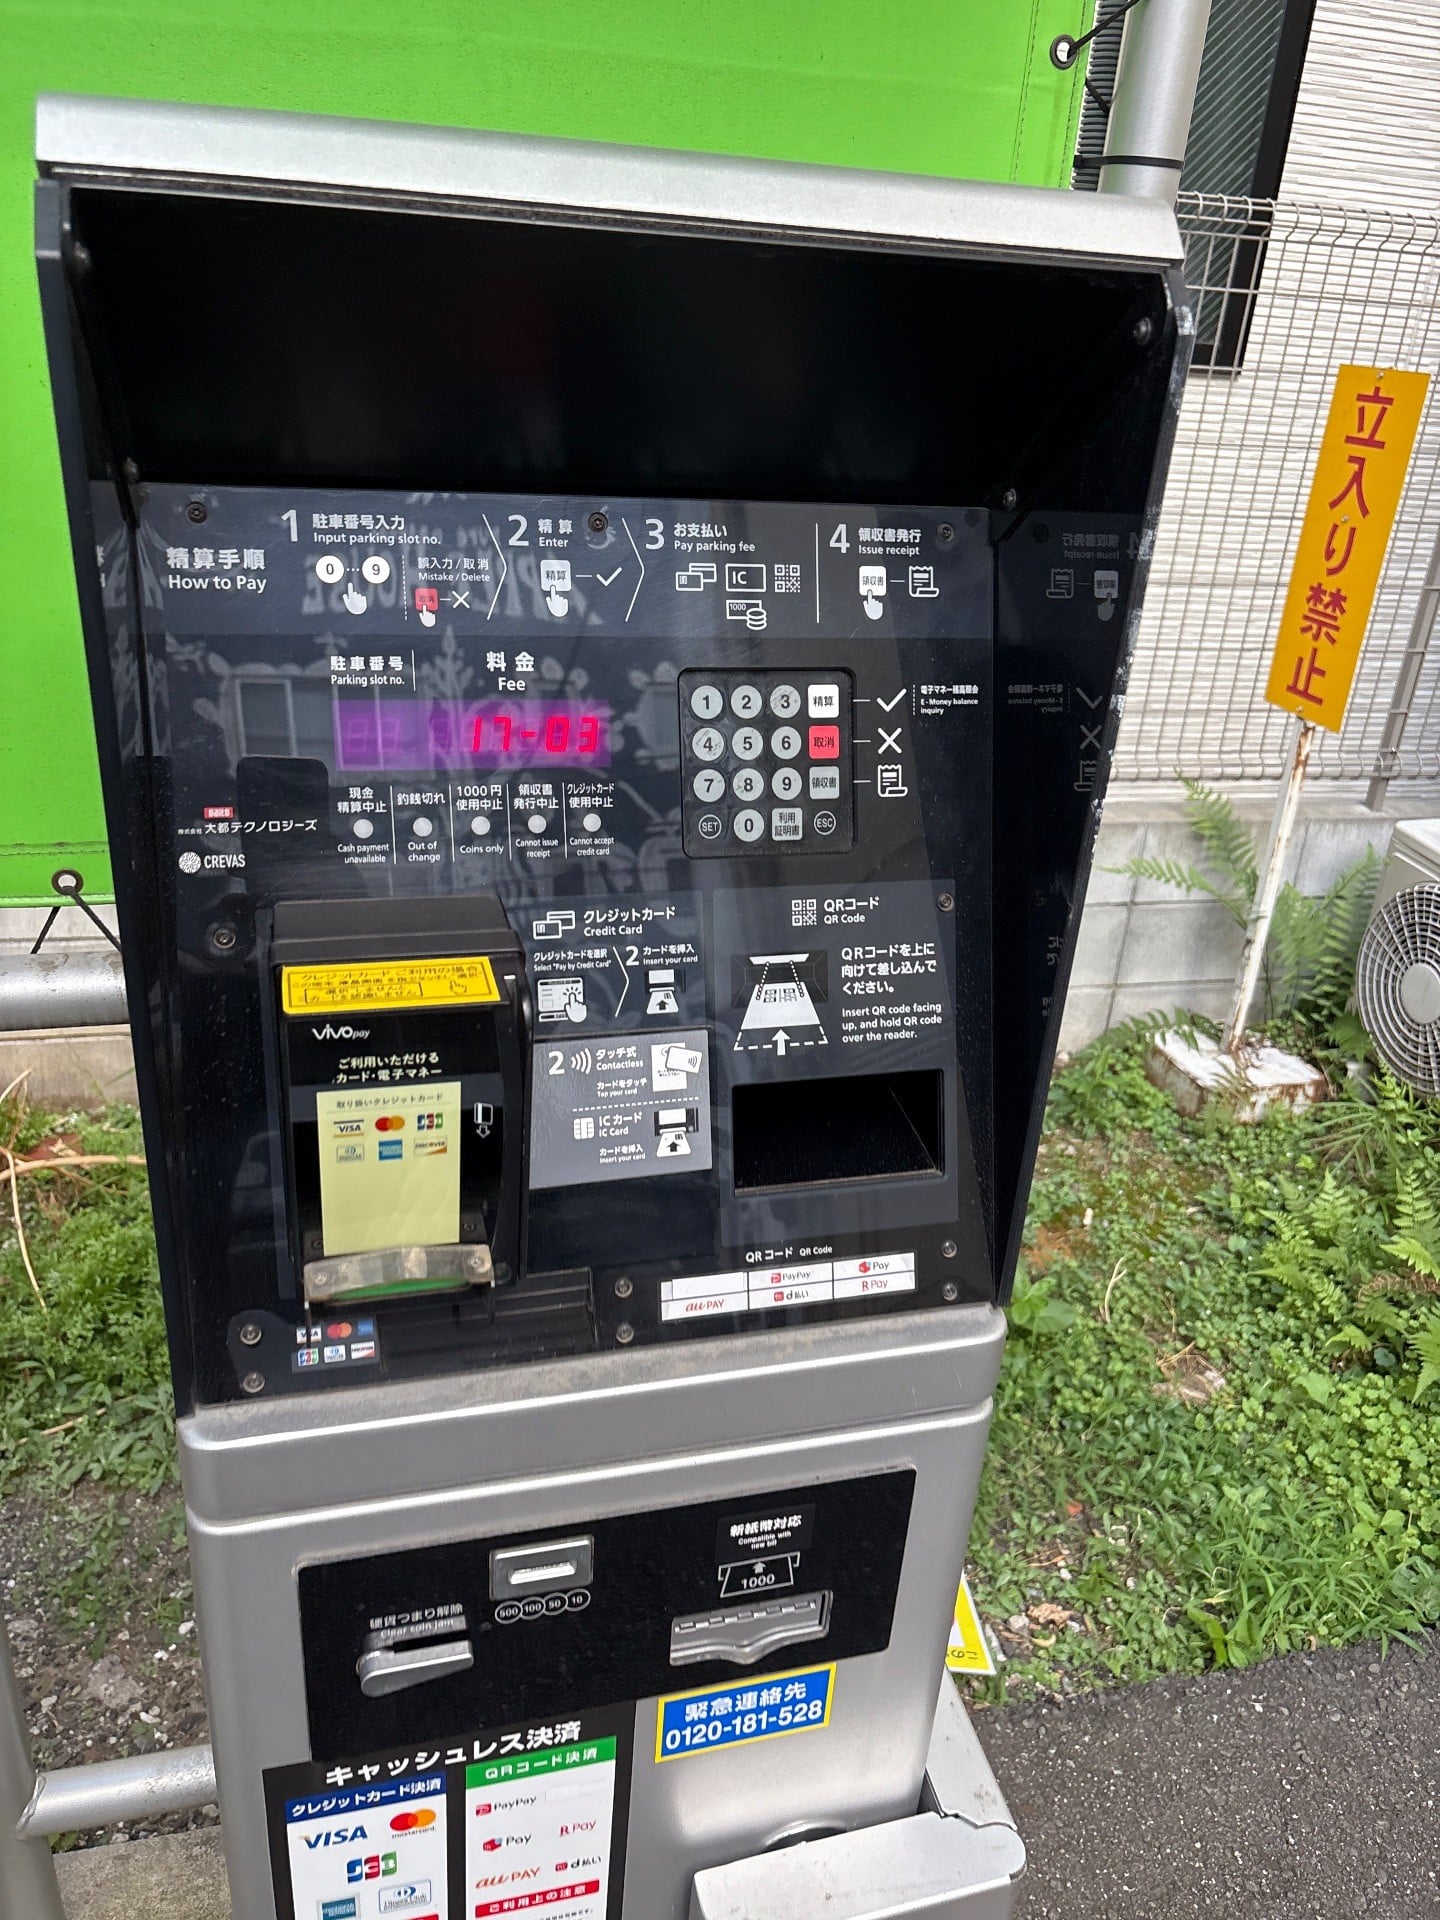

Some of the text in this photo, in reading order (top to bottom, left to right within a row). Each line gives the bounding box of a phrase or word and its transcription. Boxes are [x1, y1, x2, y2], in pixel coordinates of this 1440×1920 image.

[282, 509, 298, 542] 1
[312, 513, 404, 529] 駐車番号入力
[538, 519, 572, 534] 精算
[508, 515, 529, 546] 2
[645, 518, 664, 550] 3
[674, 523, 727, 538] お支払い
[858, 528, 921, 543] 領収書発行
[314, 533, 346, 545] Input
[350, 533, 395, 545] parking
[398, 534, 419, 544] slot
[423, 536, 441, 545] no.
[539, 538, 568, 548] Enter
[829, 524, 850, 553] 4
[674, 541, 755, 553] Pay parking fee
[859, 545, 920, 557] Issue receipt
[1286, 386, 1395, 706] 立入り禁止
[166, 547, 265, 570] 精算手順
[546, 570, 567, 581] 精算
[732, 571, 747, 584] IC
[862, 576, 884, 586] 領収書
[168, 575, 266, 593] How to Pay
[331, 656, 403, 671] 駐車番号
[486, 652, 534, 672] 料金
[331, 675, 404, 687] Parking slot no.
[499, 677, 526, 690] Fee
[702, 695, 709, 709] 1
[742, 695, 751, 709] 2
[780, 695, 790, 709] 3
[813, 696, 834, 707] 精算
[921, 707, 944, 715] inquiry
[472, 715, 599, 752] 17-03
[703, 737, 712, 751] 4
[743, 737, 752, 750] 5
[782, 736, 791, 750] 6
[814, 737, 835, 748] 取消
[568, 783, 614, 795] クレジットカード
[704, 779, 714, 792] 7
[743, 778, 753, 792] 8
[782, 777, 792, 791] 9
[812, 777, 837, 789] 領収書
[349, 787, 374, 799] 現金
[519, 784, 552, 796] 領収書
[397, 793, 445, 805] 釣銭切れ
[456, 799, 503, 811] 使用中止
[514, 798, 559, 809] 発行中止
[569, 797, 614, 808] 使用中止
[337, 801, 387, 814] 精算中止
[779, 812, 796, 823] 利用
[817, 818, 833, 827] ESC
[205, 819, 317, 834] 大都テクノロジーズ
[702, 822, 718, 831] SET
[744, 818, 753, 832] 0
[775, 825, 800, 836] 証明書
[408, 841, 437, 850] Out of
[516, 838, 558, 847] Cannot issue
[594, 837, 614, 845] accept
[338, 844, 389, 854] Cash payment
[460, 844, 504, 854] Coins only
[527, 849, 550, 858] receipt
[577, 848, 597, 856] credit
[204, 854, 246, 869] CREVAS
[344, 854, 386, 864] unavailable
[408, 853, 440, 863] change
[824, 896, 879, 912] QRコード
[584, 907, 675, 924] クレジットカード
[824, 914, 865, 924] QR Code
[584, 924, 642, 936] Credit Card
[626, 946, 639, 966] 2
[643, 944, 694, 956] カードを挿入
[842, 943, 935, 960] QRコードを上に
[665, 957, 682, 965] your
[684, 955, 698, 963] card
[842, 960, 937, 978] 向けて差し込んで
[843, 981, 894, 995] ください。
[842, 1003, 942, 1017] Insert QR code facing
[842, 1016, 942, 1031] up, and hold QR code
[843, 1031, 917, 1042] over the reader.
[596, 1046, 637, 1059] タッチ式
[339, 1052, 439, 1069] ご利用いただける
[549, 1051, 565, 1075] 2
[596, 1060, 643, 1071] Contactless
[597, 1078, 647, 1090] カードをタッチ
[337, 1093, 443, 1108] 取り扱いクレジットカード
[599, 1112, 642, 1127] IC カード
[600, 1127, 628, 1137] IC Card
[600, 1144, 643, 1156] カードを挿入
[618, 1155, 632, 1163] your
[633, 1153, 645, 1161] card
[746, 1251, 762, 1262] QR
[800, 1248, 811, 1256] QR
[813, 1246, 832, 1255] Code
[873, 1262, 889, 1270] Pay
[783, 1271, 811, 1280] PayPay
[730, 1515, 802, 1538] 新紙幣対応
[738, 1534, 775, 1545] Compatible
[741, 1573, 775, 1589] 1000
[499, 1595, 583, 1616] 500 100 50 10
[685, 1682, 806, 1722] 緊急連絡先
[666, 1700, 822, 1749] 0120-181-528
[326, 1720, 581, 1786] キャッシュレス決済
[485, 1748, 598, 1779] QRコード決済
[292, 1778, 441, 1817] クレジットカード決済
[494, 1795, 537, 1810] PayPay
[560, 1820, 596, 1836] R Pay
[301, 1825, 368, 1850] VISA
[506, 1834, 531, 1846] Pay
[347, 1851, 397, 1884] JCB
[511, 1867, 540, 1882] PAY
